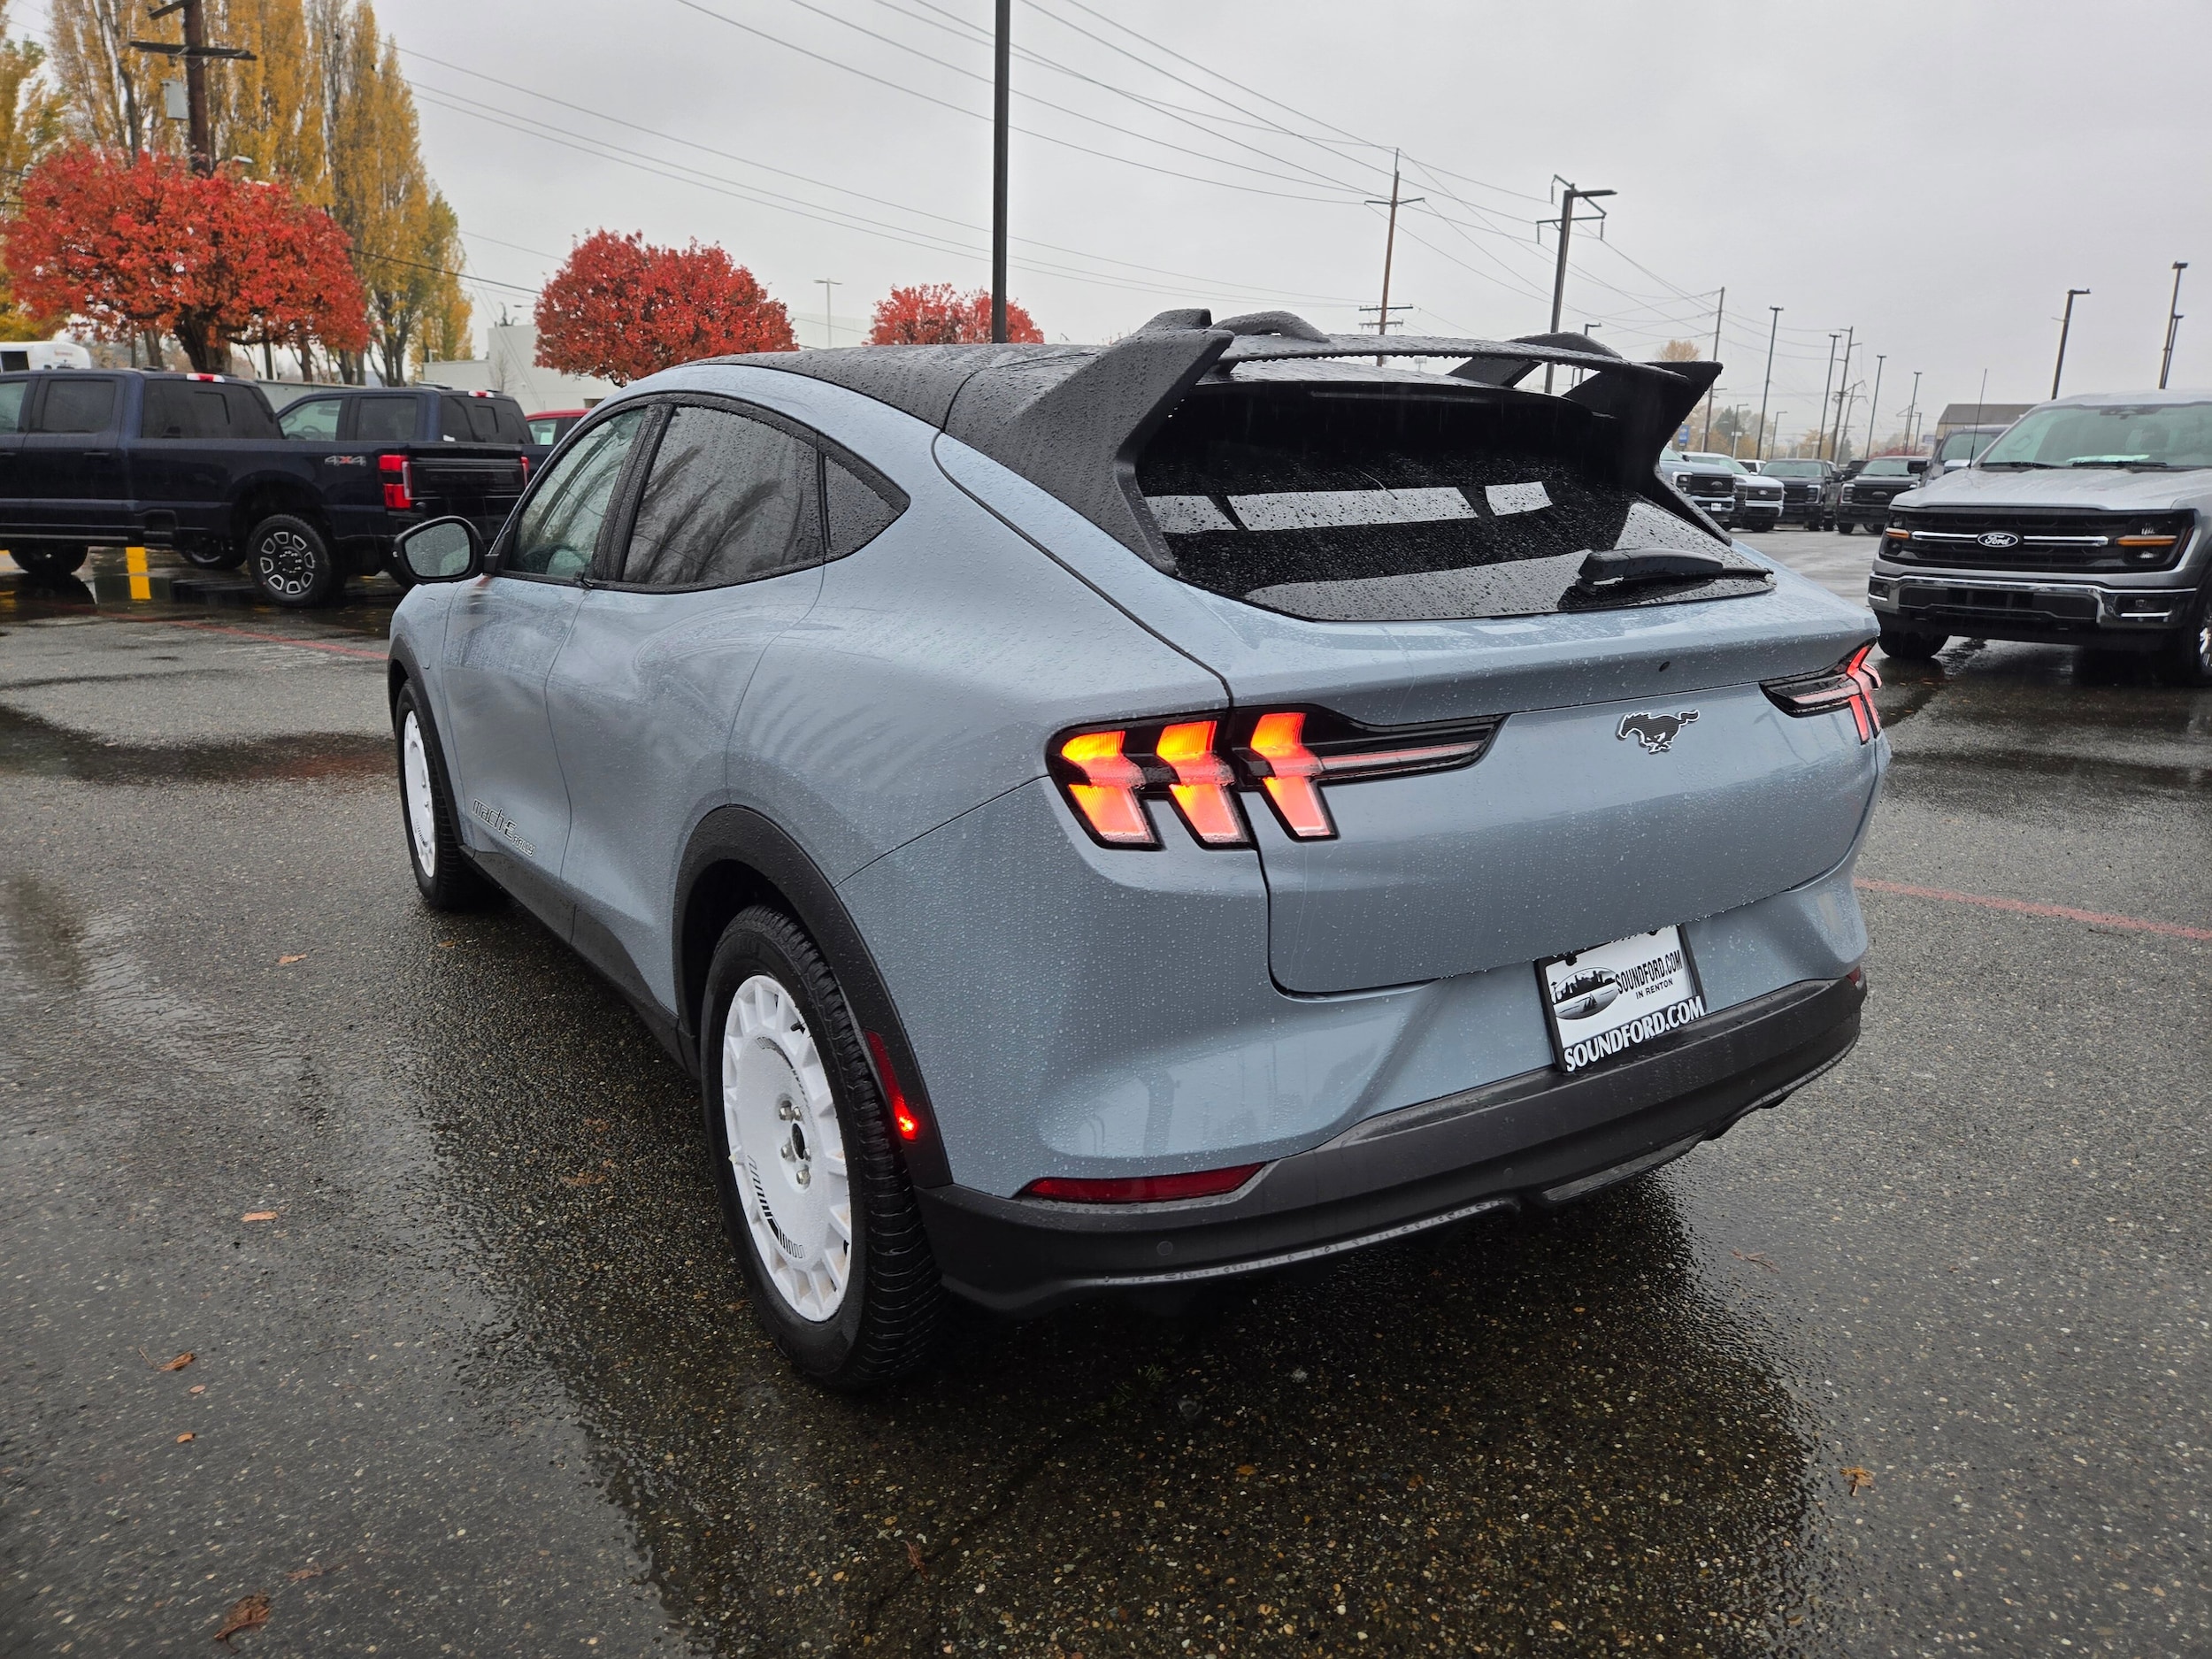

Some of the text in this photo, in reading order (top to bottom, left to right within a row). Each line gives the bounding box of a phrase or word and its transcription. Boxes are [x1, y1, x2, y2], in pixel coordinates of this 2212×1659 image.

[1985, 534, 2011, 545] Ford
[1615, 949, 1683, 995] SOUNDFORD.COM
[1636, 978, 1674, 1000] IN RENTON
[1563, 995, 1706, 1072] SOUNDFORD.COM
